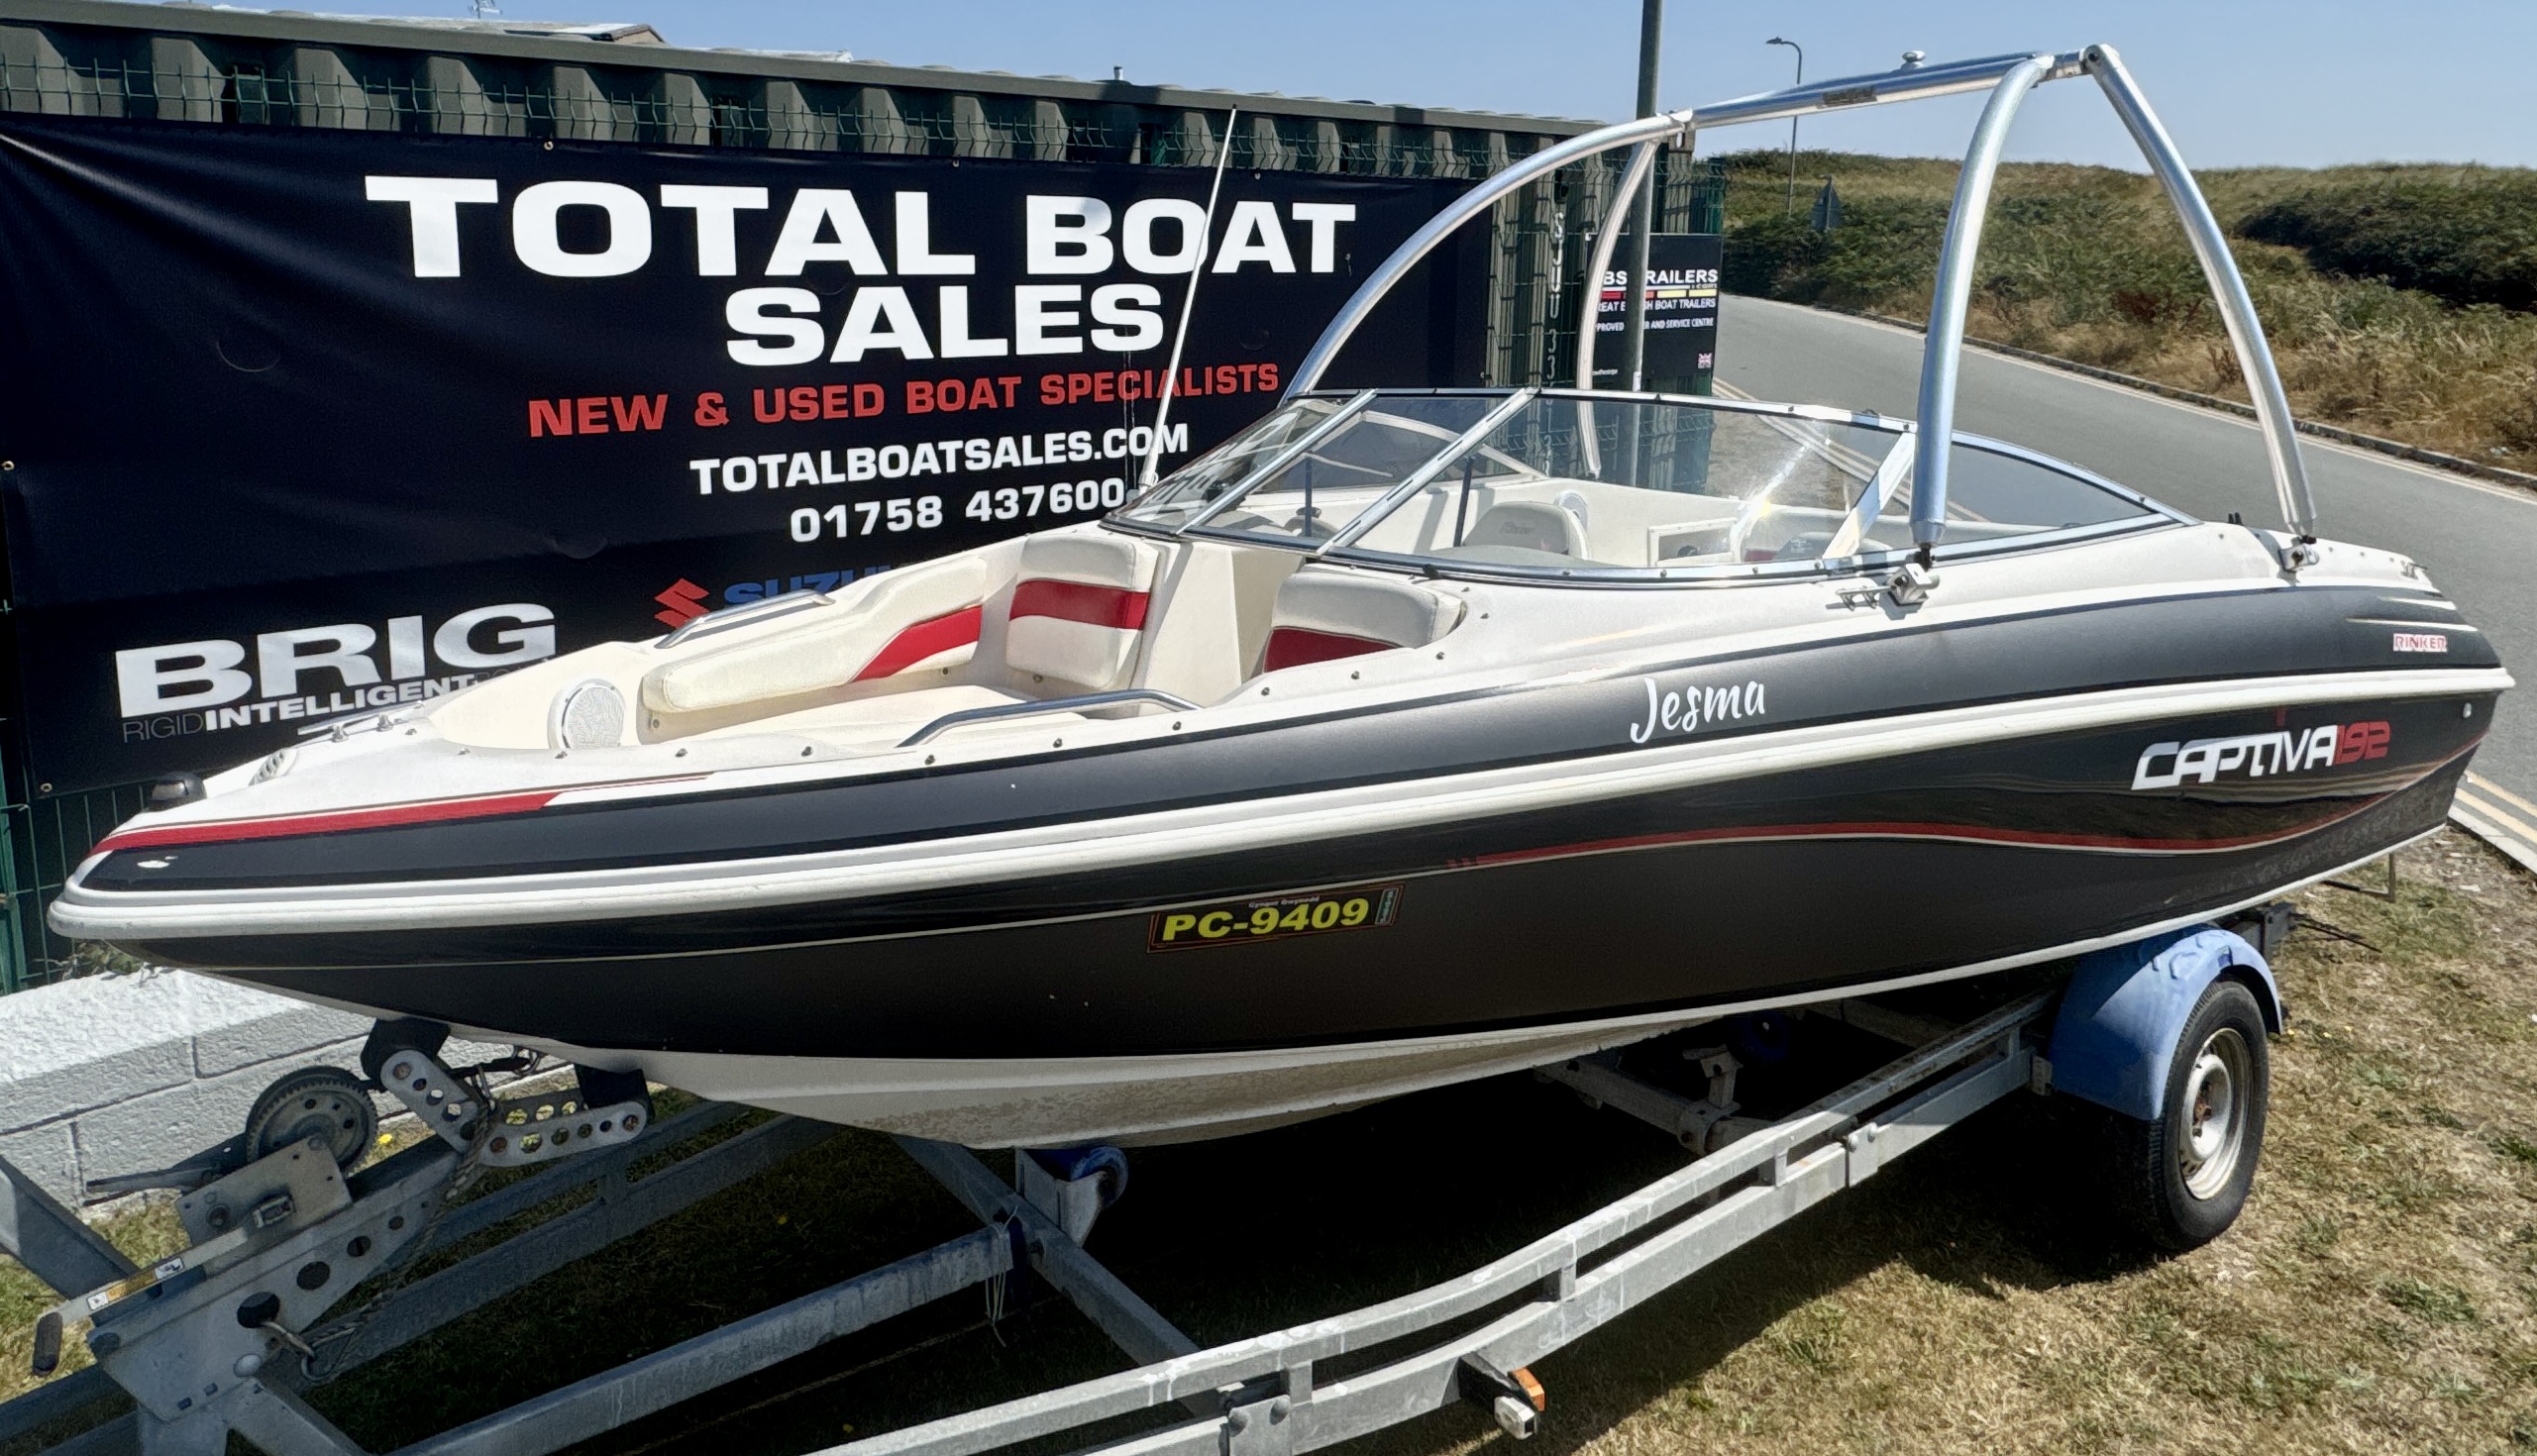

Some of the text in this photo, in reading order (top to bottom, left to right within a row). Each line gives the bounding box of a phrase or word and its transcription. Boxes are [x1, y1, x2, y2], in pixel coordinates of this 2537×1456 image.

[366, 175, 1356, 278] TOTAL BOAT
[1603, 268, 1719, 285] BS RAILERS
[1654, 299, 1677, 310] BOAT
[1679, 297, 1717, 309] TRAILERS
[725, 283, 1164, 366] SALES
[528, 363, 1279, 438] NEW & USED BOAT SPECIALISTS
[689, 422, 1189, 495] TOTALBOATSALES.COM
[791, 477, 1125, 543] 01758 437600
[115, 602, 557, 719] BRIG
[2393, 634, 2447, 651] RINKER
[1630, 676, 1765, 744] Jesma
[1162, 898, 1370, 941] PC-9409
